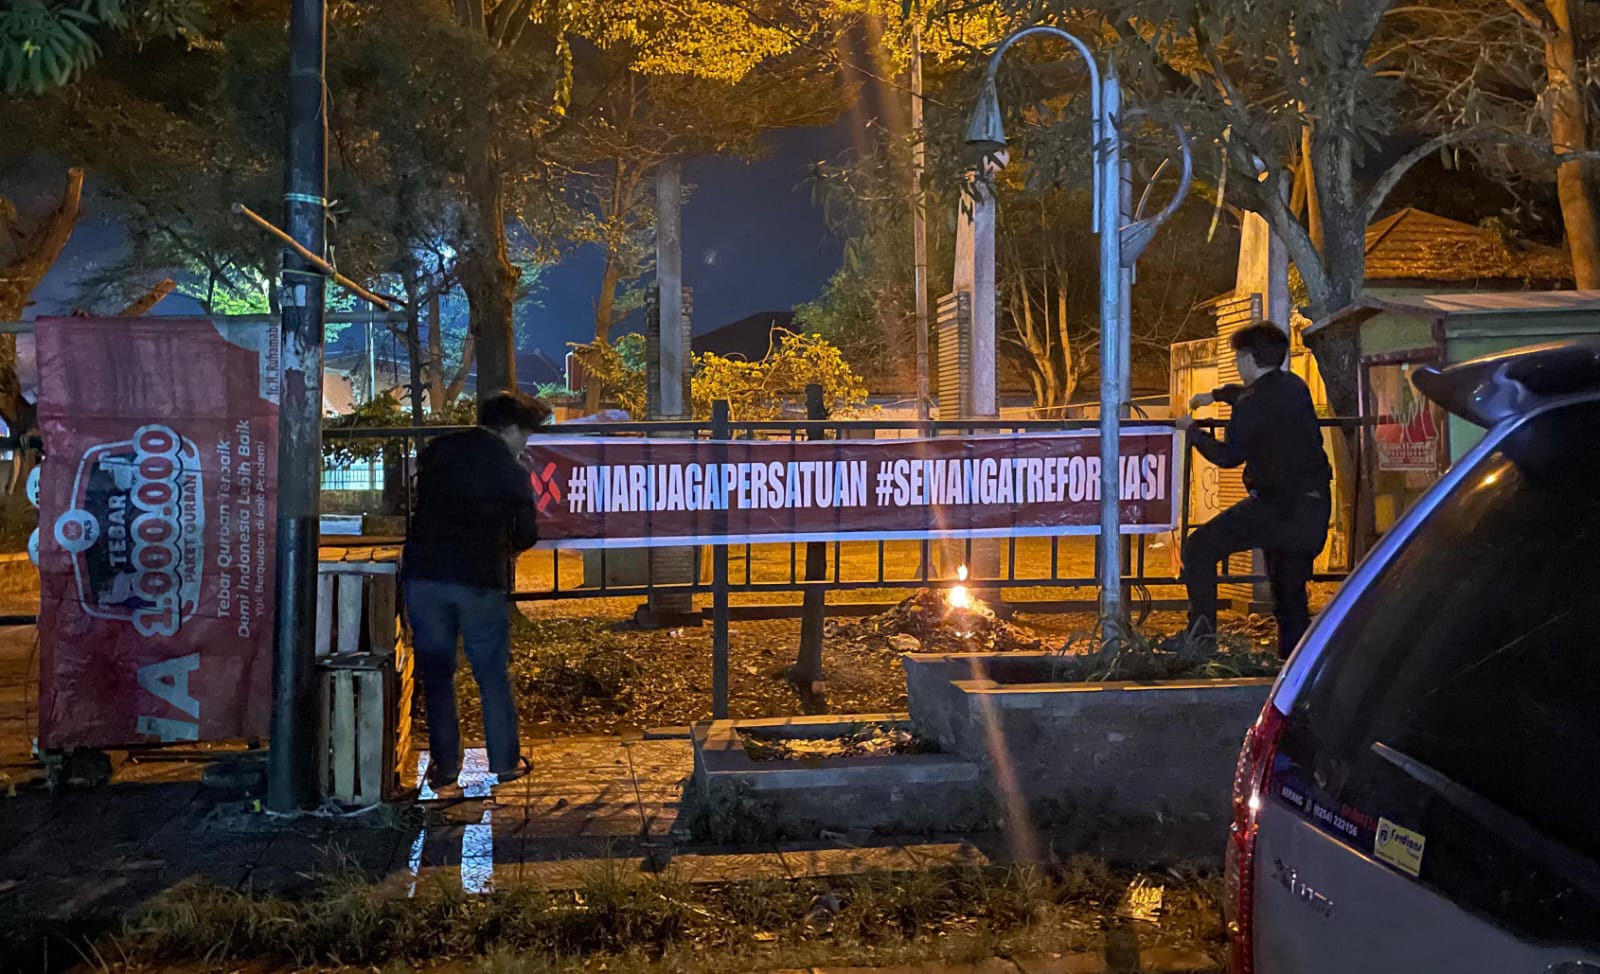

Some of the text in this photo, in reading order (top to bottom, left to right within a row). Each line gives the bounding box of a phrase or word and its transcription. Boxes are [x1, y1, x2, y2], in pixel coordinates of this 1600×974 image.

[567, 460, 867, 513] #MARIJAGAPERSATUAN
[83, 519, 93, 541] PKS
[108, 494, 128, 567] TEBAR
[137, 430, 174, 630] 1.000.000
[182, 474, 197, 583] PAKET QURBAN
[217, 504, 232, 567] Qurban
[236, 419, 251, 638] Demi Indonesia Lebih Baik
[254, 519, 265, 531] di
[217, 573, 231, 618] Tebar
[254, 596, 265, 617] Yuk
